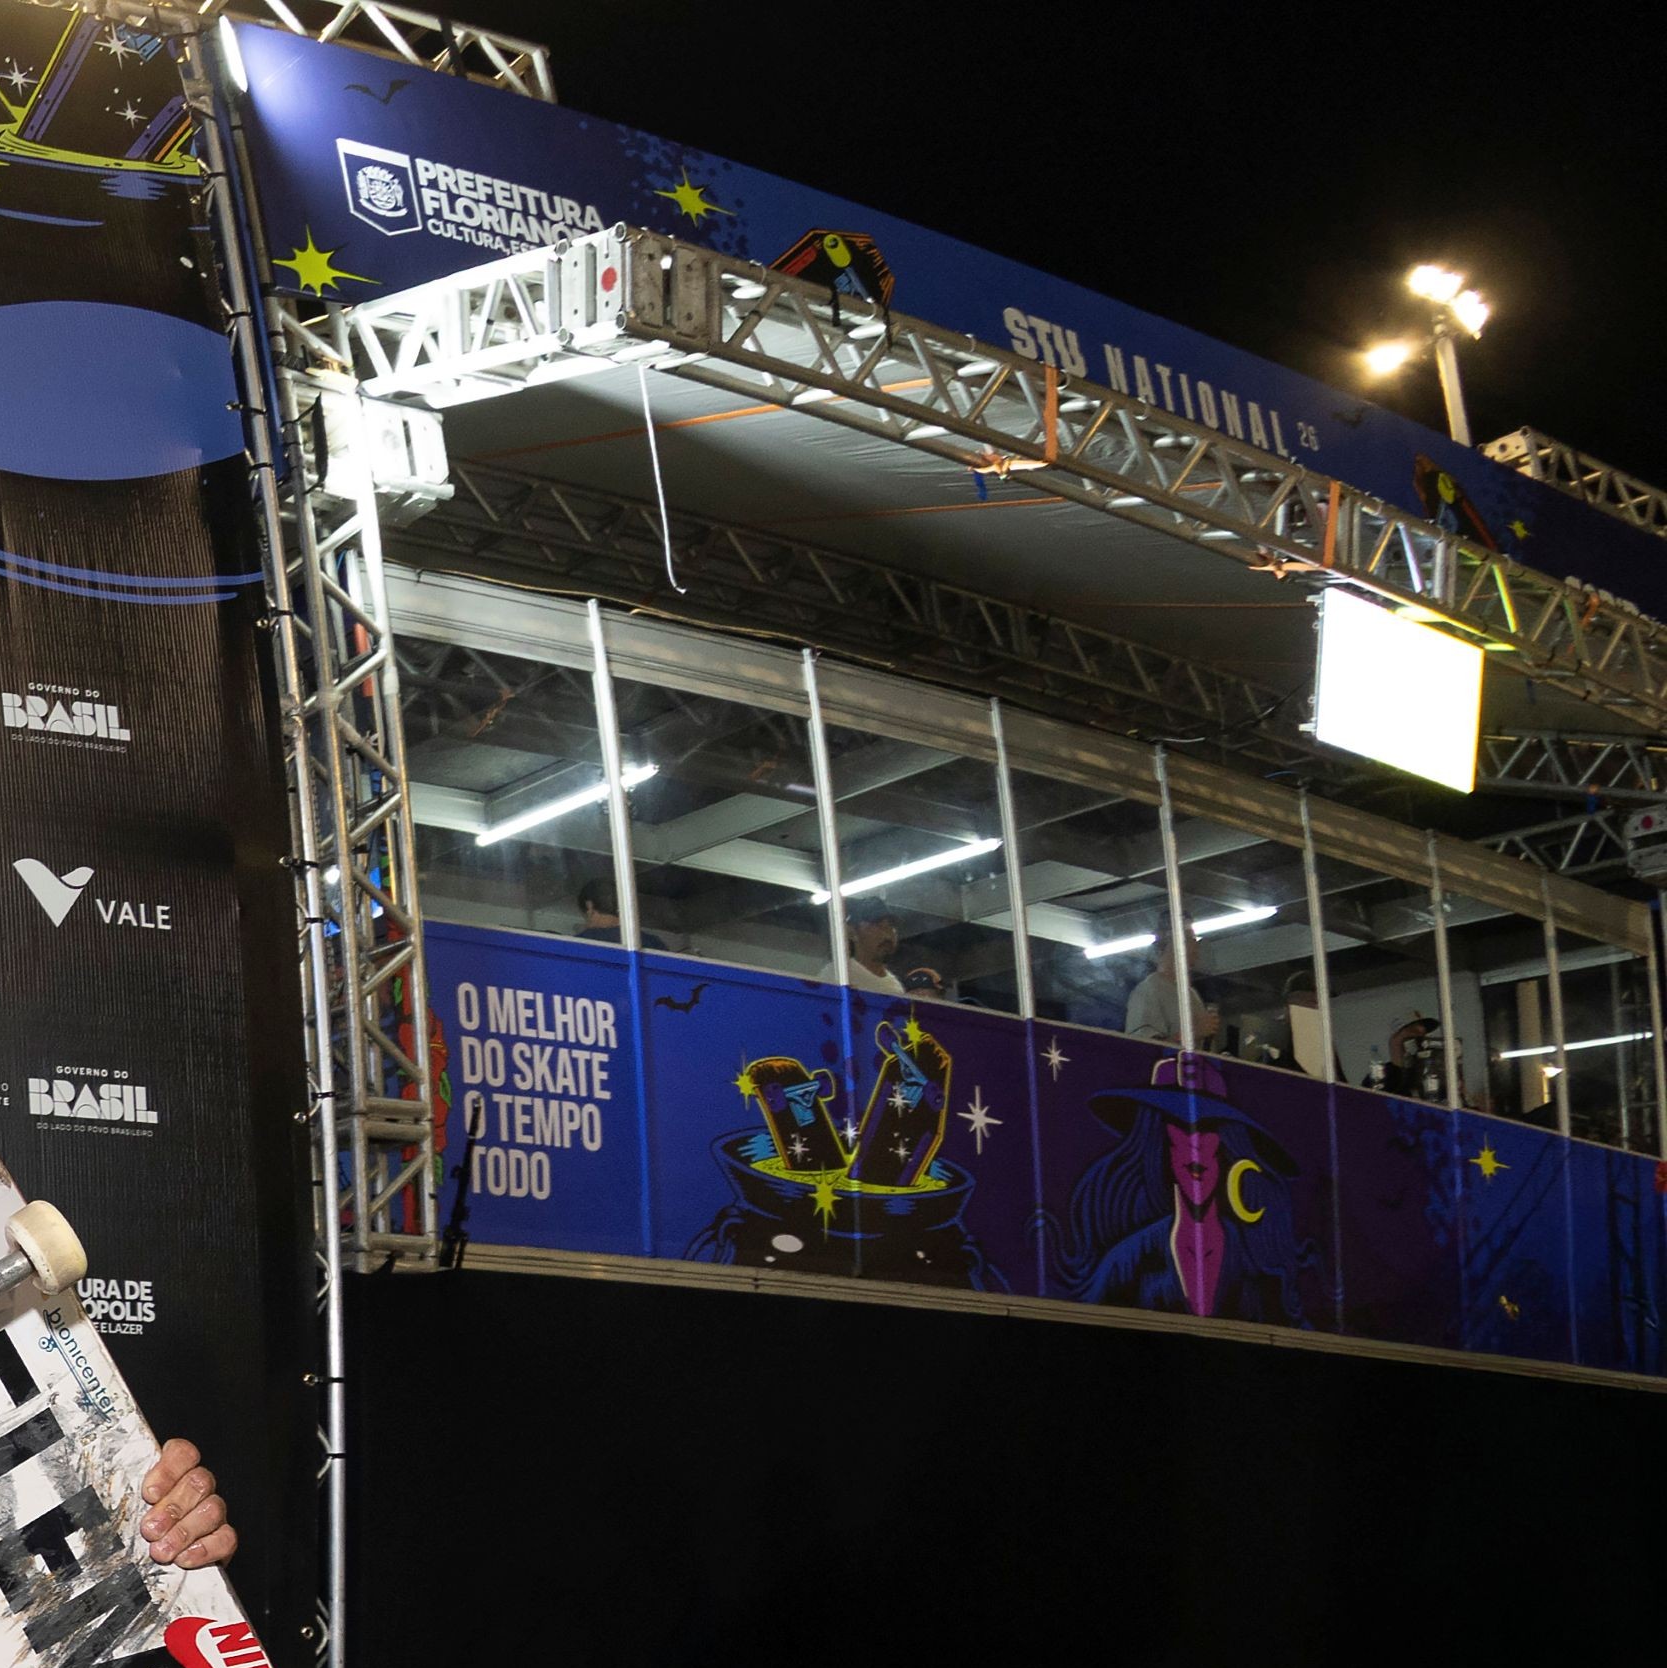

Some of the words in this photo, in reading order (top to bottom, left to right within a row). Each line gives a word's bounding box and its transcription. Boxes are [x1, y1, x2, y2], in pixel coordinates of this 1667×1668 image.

[415, 157, 604, 232] PREFEITURA
[1003, 306, 1088, 378] STU
[1104, 343, 1289, 458] NATIONAL
[1296, 421, 1320, 451] 26
[2, 692, 130, 741] BRASIL
[27, 682, 80, 696] GOVERNO
[85, 689, 100, 698] DO
[95, 898, 172, 931] VALE
[457, 982, 480, 1031] O
[487, 986, 618, 1049] MELHOR
[56, 1065, 108, 1078] GOVERNO
[113, 1069, 128, 1080] DO
[461, 1036, 505, 1088] DO
[512, 1042, 611, 1100] SKATE
[28, 1078, 158, 1124] BRASIL
[464, 1090, 487, 1140] O
[492, 1093, 602, 1152] TEMPO
[472, 1145, 551, 1200] TODO
[121, 1279, 152, 1301] DE
[44, 1305, 117, 1418] bionicenter
